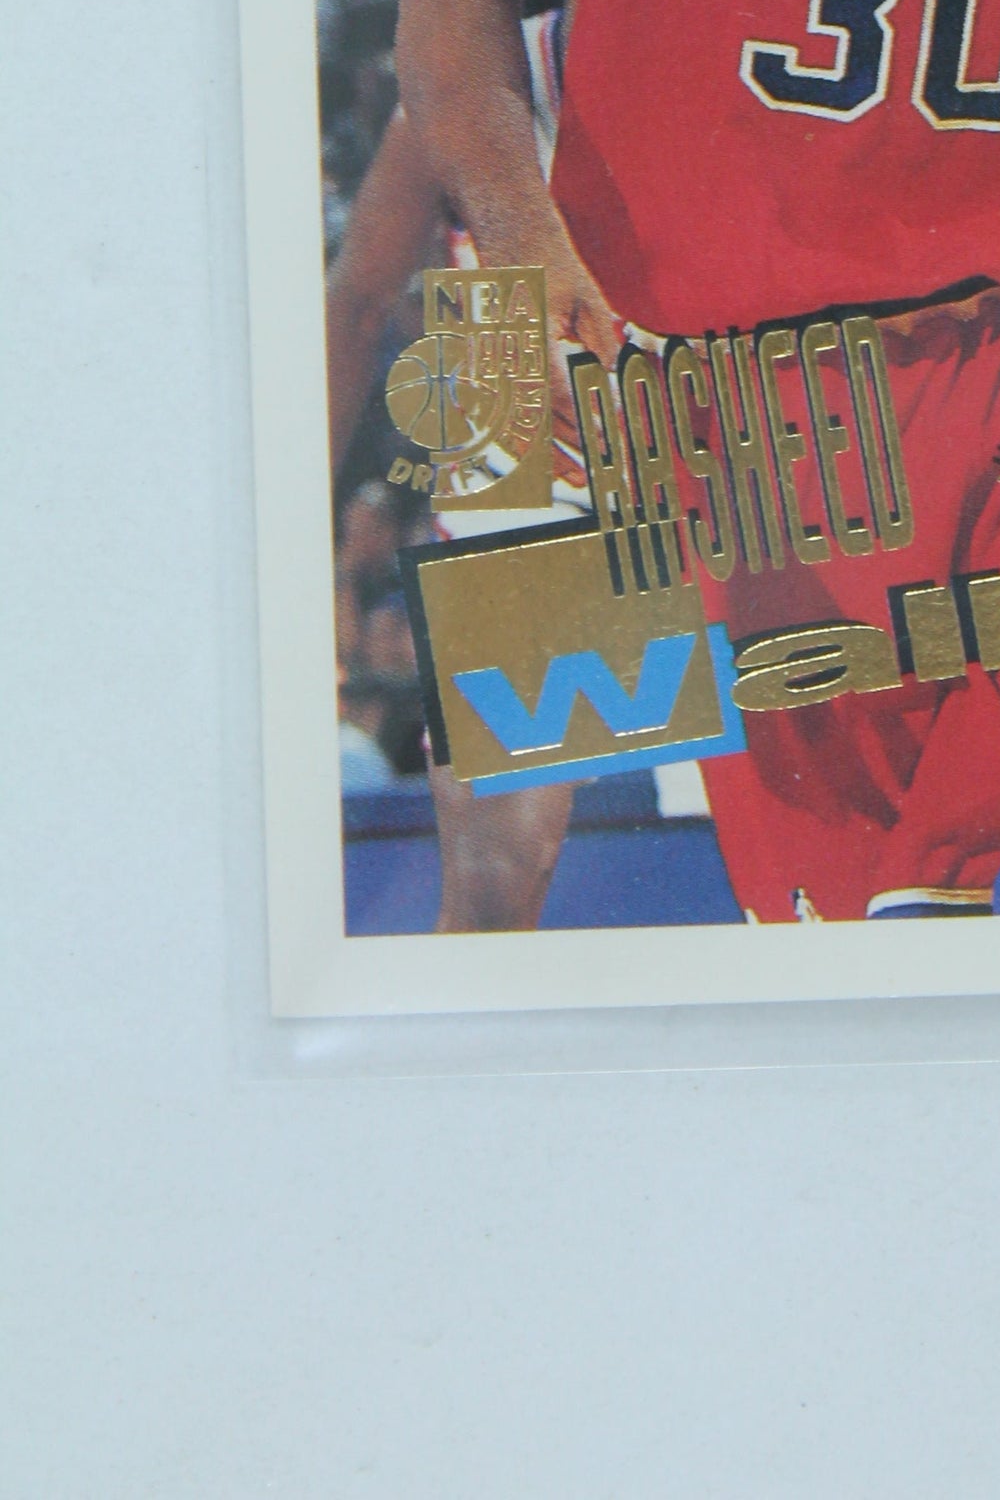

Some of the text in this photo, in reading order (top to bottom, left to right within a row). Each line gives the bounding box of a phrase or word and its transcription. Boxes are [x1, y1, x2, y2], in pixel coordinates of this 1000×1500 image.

[433, 279, 541, 325] NBA
[466, 329, 543, 382] 1995
[569, 315, 915, 599] RASHEED
